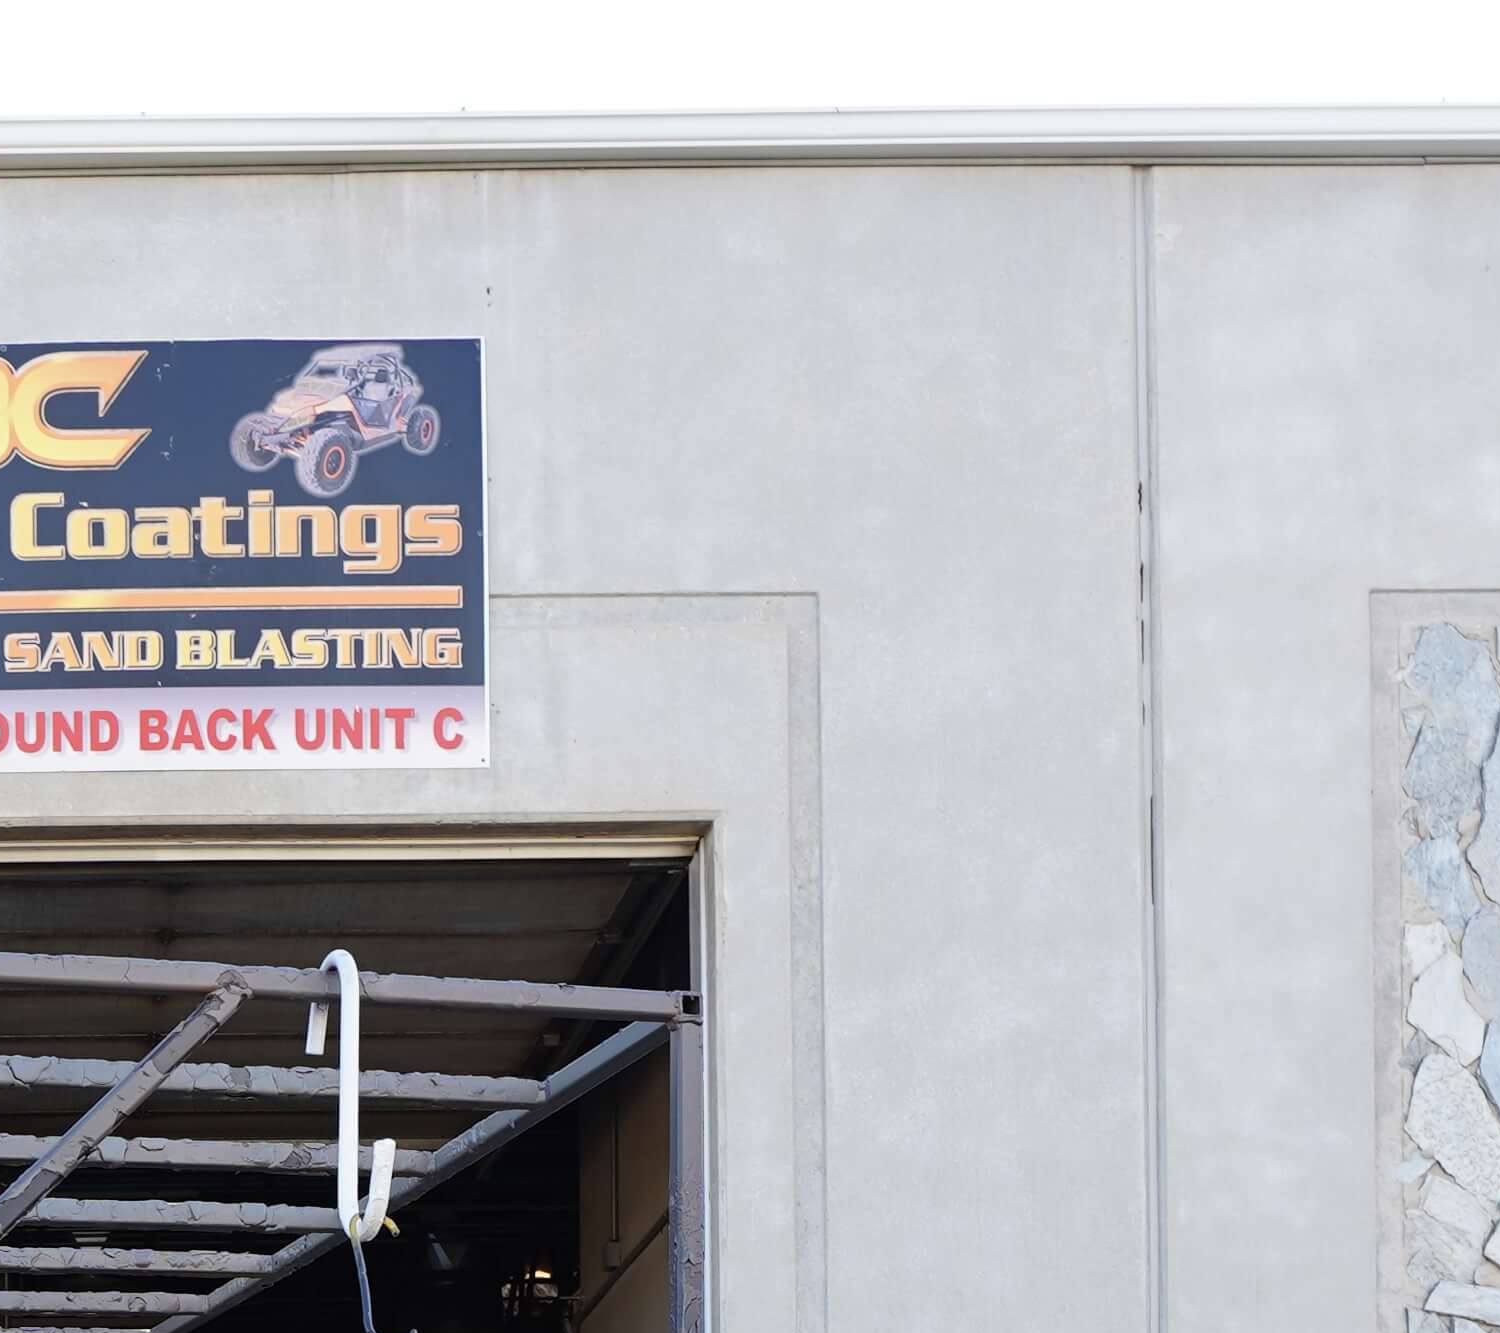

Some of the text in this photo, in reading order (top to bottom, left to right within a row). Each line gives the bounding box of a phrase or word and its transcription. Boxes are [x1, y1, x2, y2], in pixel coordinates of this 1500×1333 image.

[10, 488, 463, 574] Coatings
[3, 630, 165, 672] SAND
[175, 628, 463, 670] BLASTING
[138, 708, 277, 752] BACK
[294, 707, 415, 750] UNIT
[433, 706, 465, 750] C
